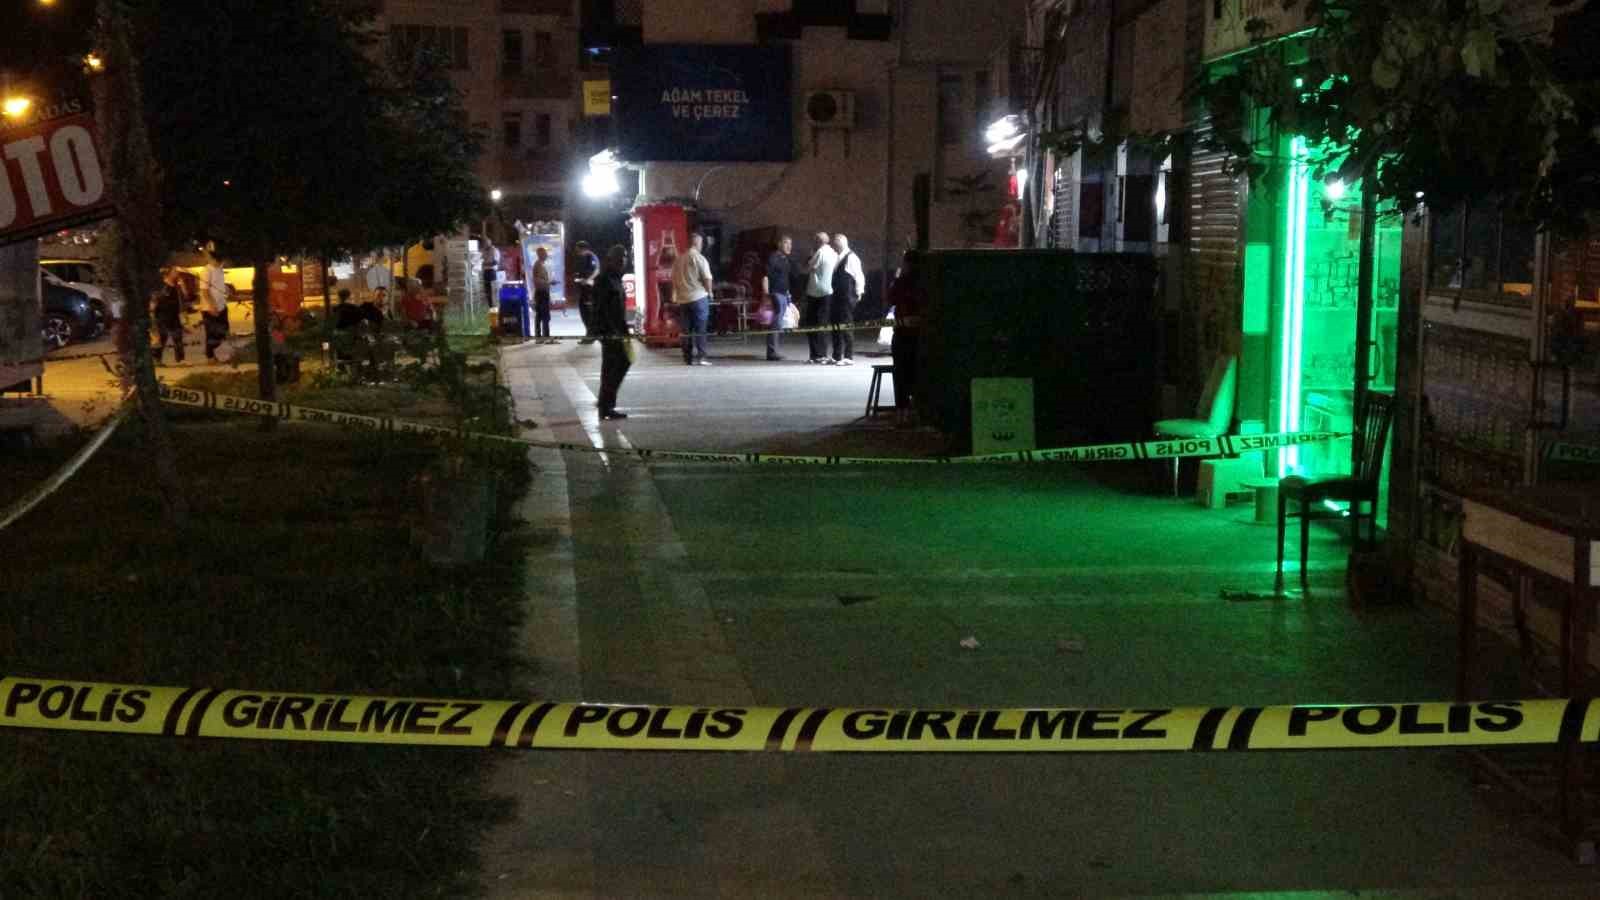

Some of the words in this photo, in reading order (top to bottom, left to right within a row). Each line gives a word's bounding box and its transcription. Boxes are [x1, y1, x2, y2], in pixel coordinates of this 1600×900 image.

[704, 89, 750, 103] TEKEL
[672, 105, 690, 118] VE
[693, 105, 739, 121] ÇEREZ
